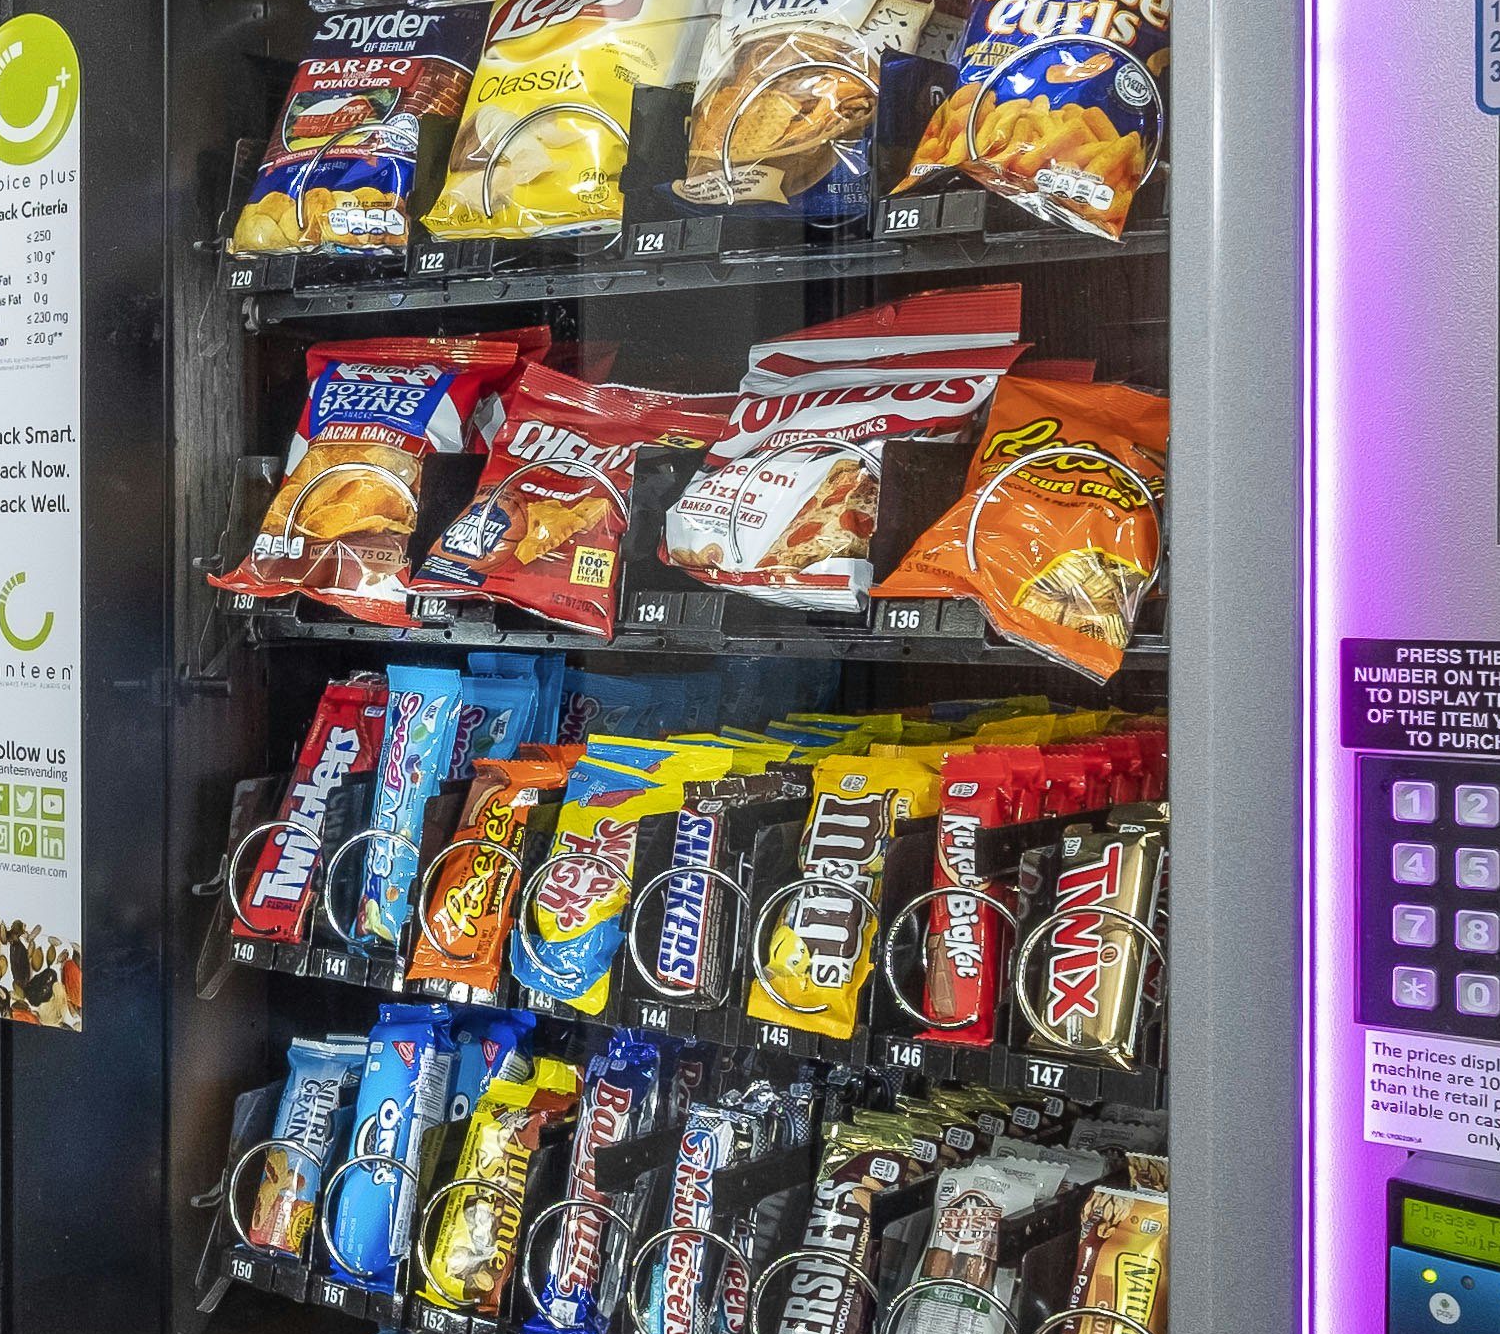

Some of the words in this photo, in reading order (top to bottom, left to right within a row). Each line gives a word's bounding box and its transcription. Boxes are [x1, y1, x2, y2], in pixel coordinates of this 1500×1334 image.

[313, 10, 440, 53] Snyder
[379, 39, 418, 52] BERLIN
[313, 77, 354, 90] POTATO
[355, 75, 393, 88] CHIPS
[477, 61, 586, 103] Classic
[40, 169, 75, 191] plus
[21, 200, 69, 220] Criteria
[887, 208, 920, 229] 126
[636, 233, 665, 253] 124
[322, 383, 426, 402] POTATO
[318, 395, 420, 417] SKINS
[25, 424, 76, 446] Smart.
[361, 426, 406, 446] RANCH
[31, 460, 70, 478] Now.
[31, 494, 70, 513] Well.
[637, 605, 665, 623] 134
[887, 610, 920, 629] 136
[1396, 648, 1462, 665] PRESS
[1354, 666, 1438, 685] NUMBER
[1444, 669, 1473, 686] ON
[1365, 687, 1392, 704] TO
[1398, 688, 1481, 707] DISPLAY
[1367, 708, 1394, 724] OF
[1395, 709, 1437, 727] THE
[1441, 710, 1489, 729] ITEM
[1406, 730, 1433, 748] TO
[46, 747, 67, 765] us
[233, 943, 255, 961] 140
[641, 1009, 667, 1028] 144
[760, 1025, 790, 1046] 145
[1372, 1041, 1403, 1058] The
[1407, 1048, 1457, 1066] prices
[1029, 1066, 1064, 1088] 147
[1372, 1062, 1443, 1083] machine
[1446, 1073, 1475, 1087] are
[1479, 1076, 1500, 1092] 10
[1370, 1078, 1407, 1096] than
[1412, 1083, 1440, 1101] the
[1444, 1090, 1489, 1108] retail
[1371, 1098, 1444, 1120] available
[1448, 1110, 1470, 1124] on
[1410, 1203, 1477, 1231] Please
[1421, 1223, 1445, 1240] or
